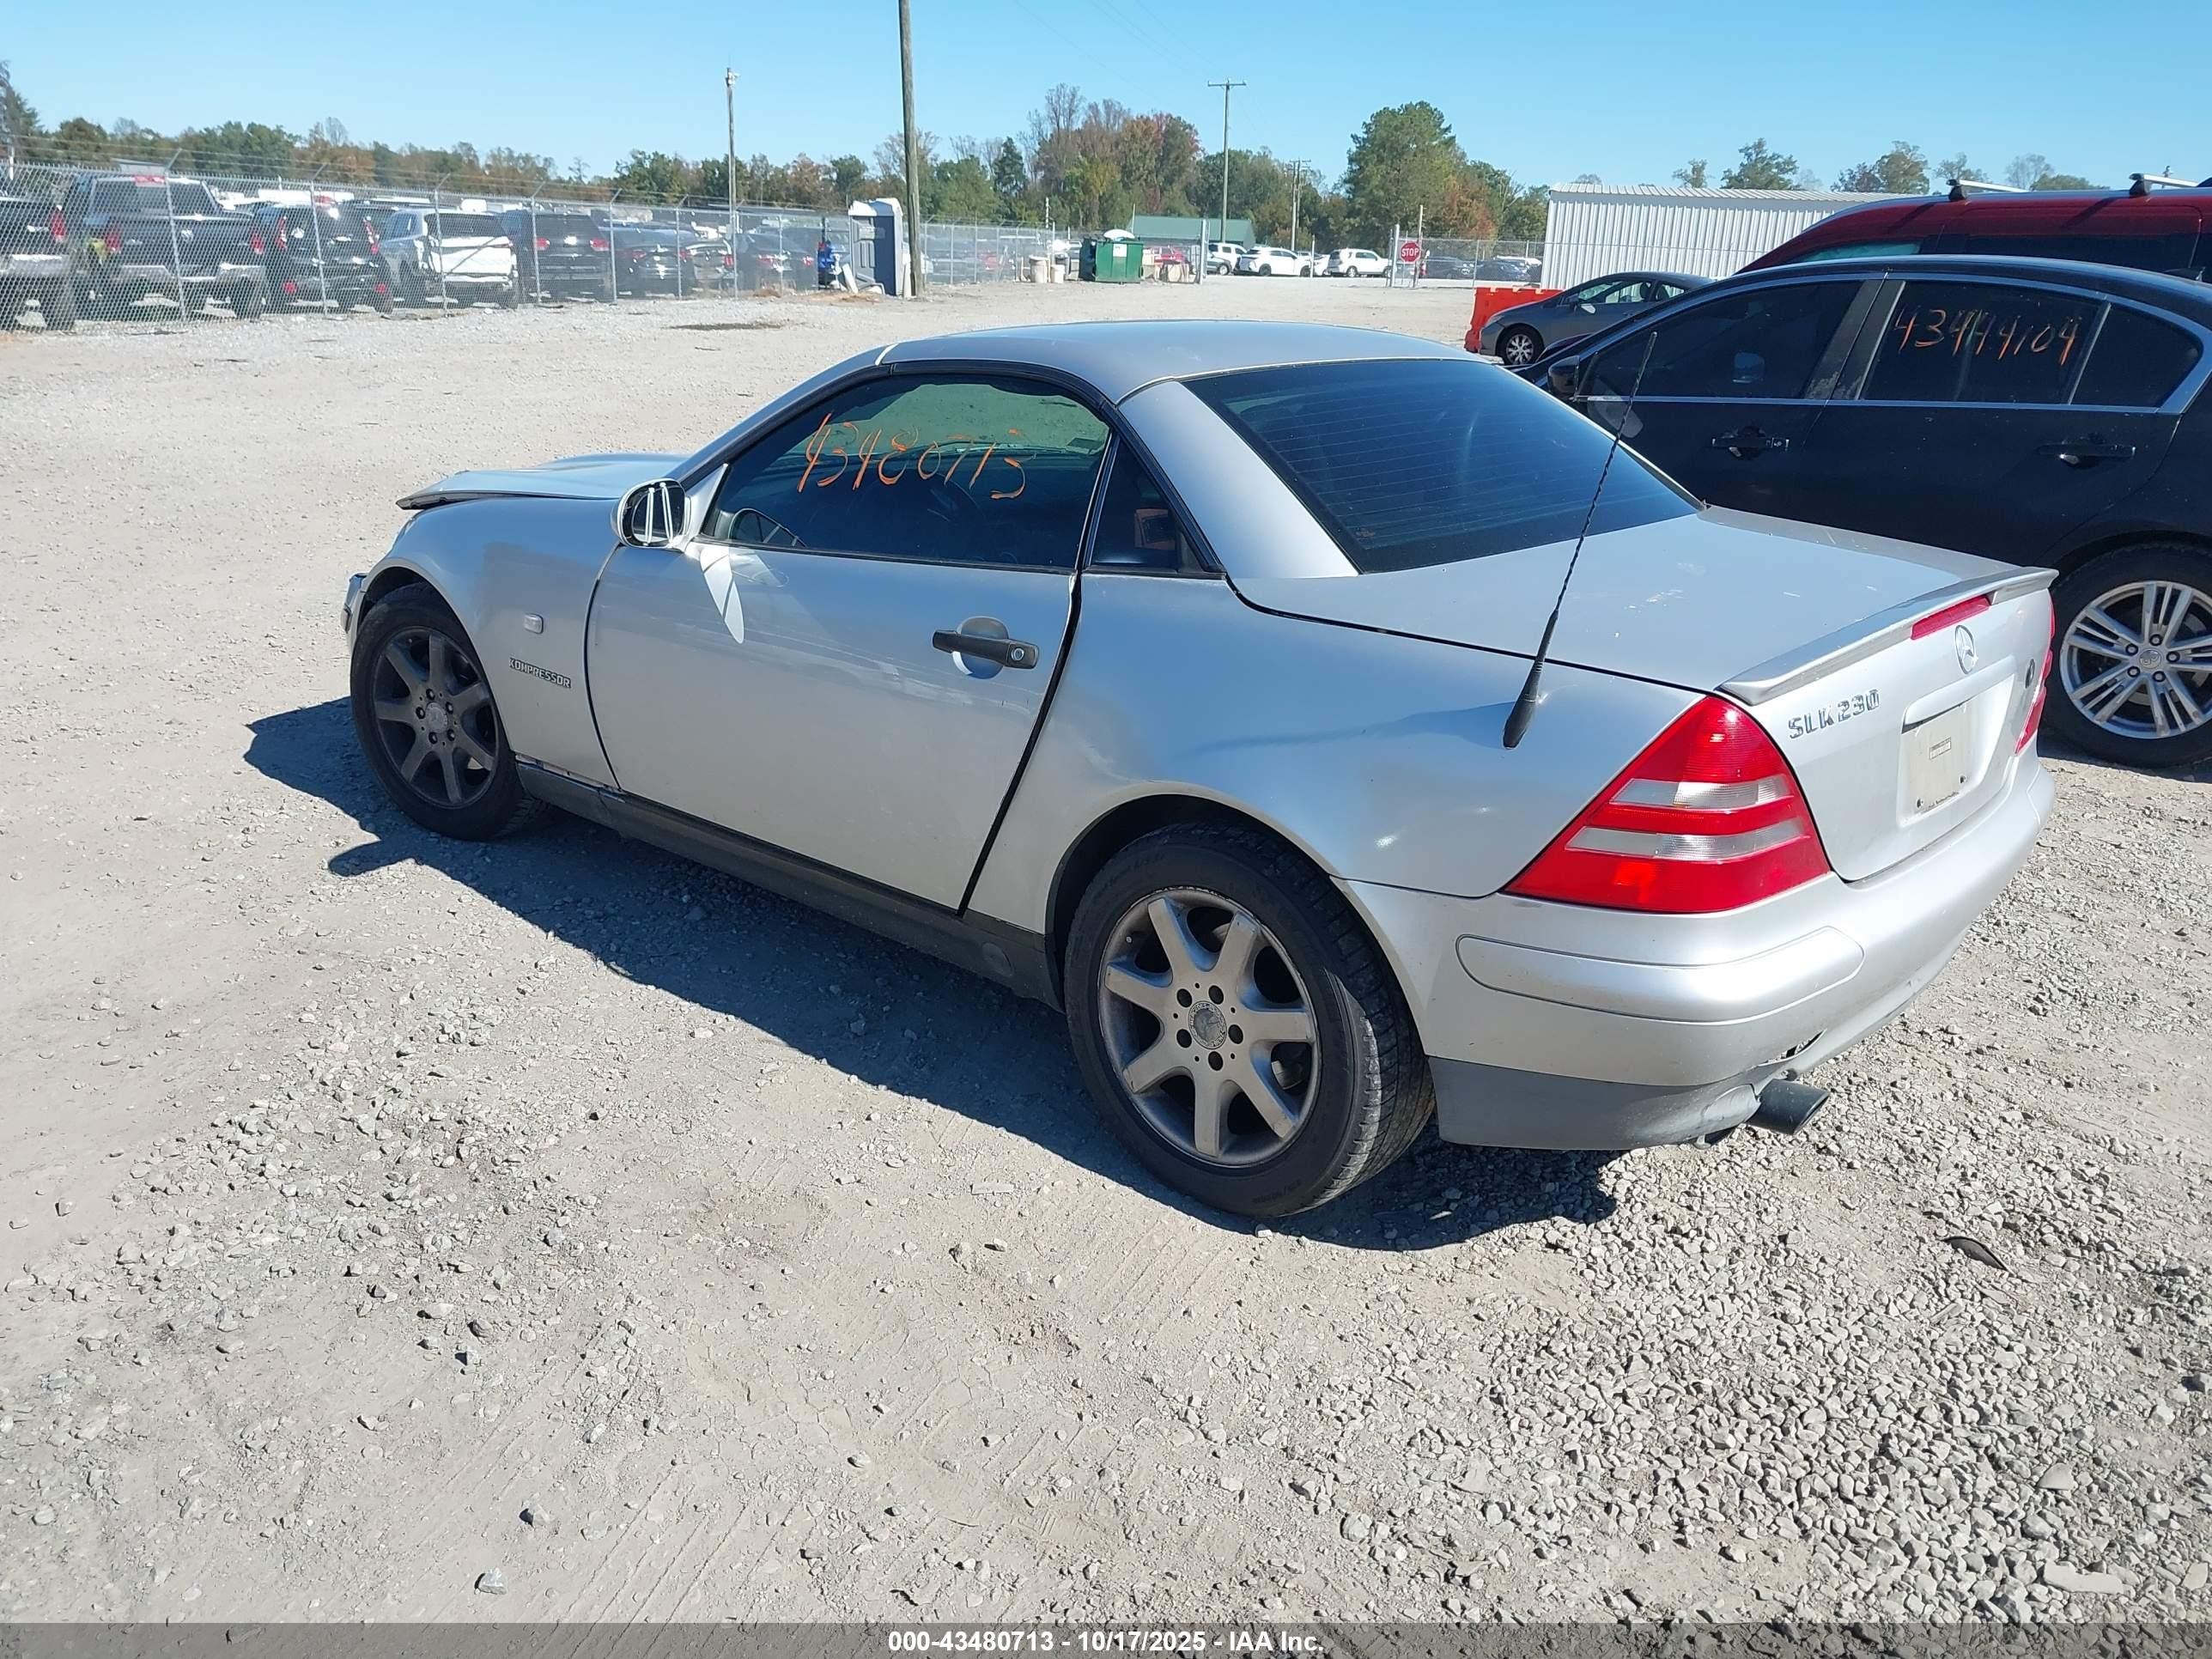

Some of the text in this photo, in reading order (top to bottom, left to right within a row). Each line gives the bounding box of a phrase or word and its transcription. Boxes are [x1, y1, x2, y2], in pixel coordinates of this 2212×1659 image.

[1401, 247, 1419, 258] STOP
[508, 657, 572, 689] KOMPRESSOR
[1788, 689, 1881, 739] SLK 230
